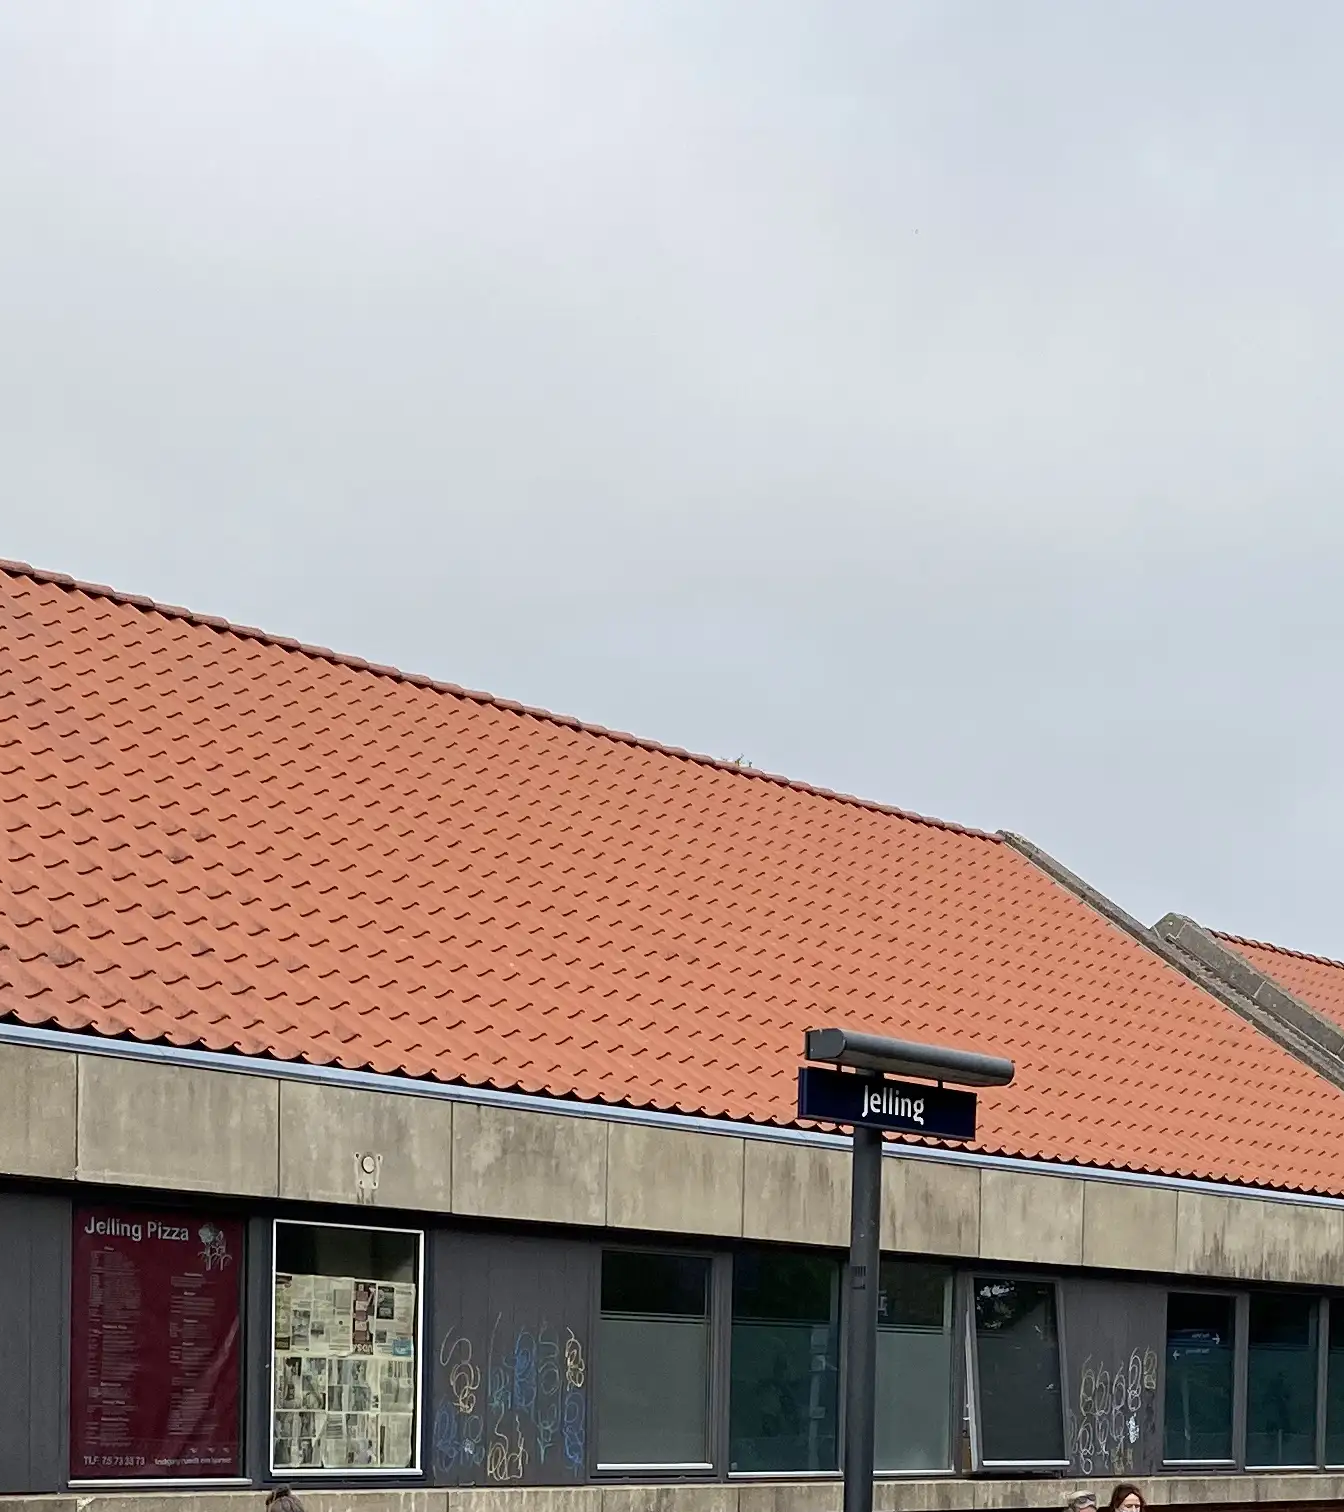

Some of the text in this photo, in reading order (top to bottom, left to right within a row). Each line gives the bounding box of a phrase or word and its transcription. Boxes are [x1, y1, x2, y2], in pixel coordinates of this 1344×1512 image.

[861, 1084, 925, 1126] Jelling
[84, 1216, 189, 1242] Jelling Pizza
